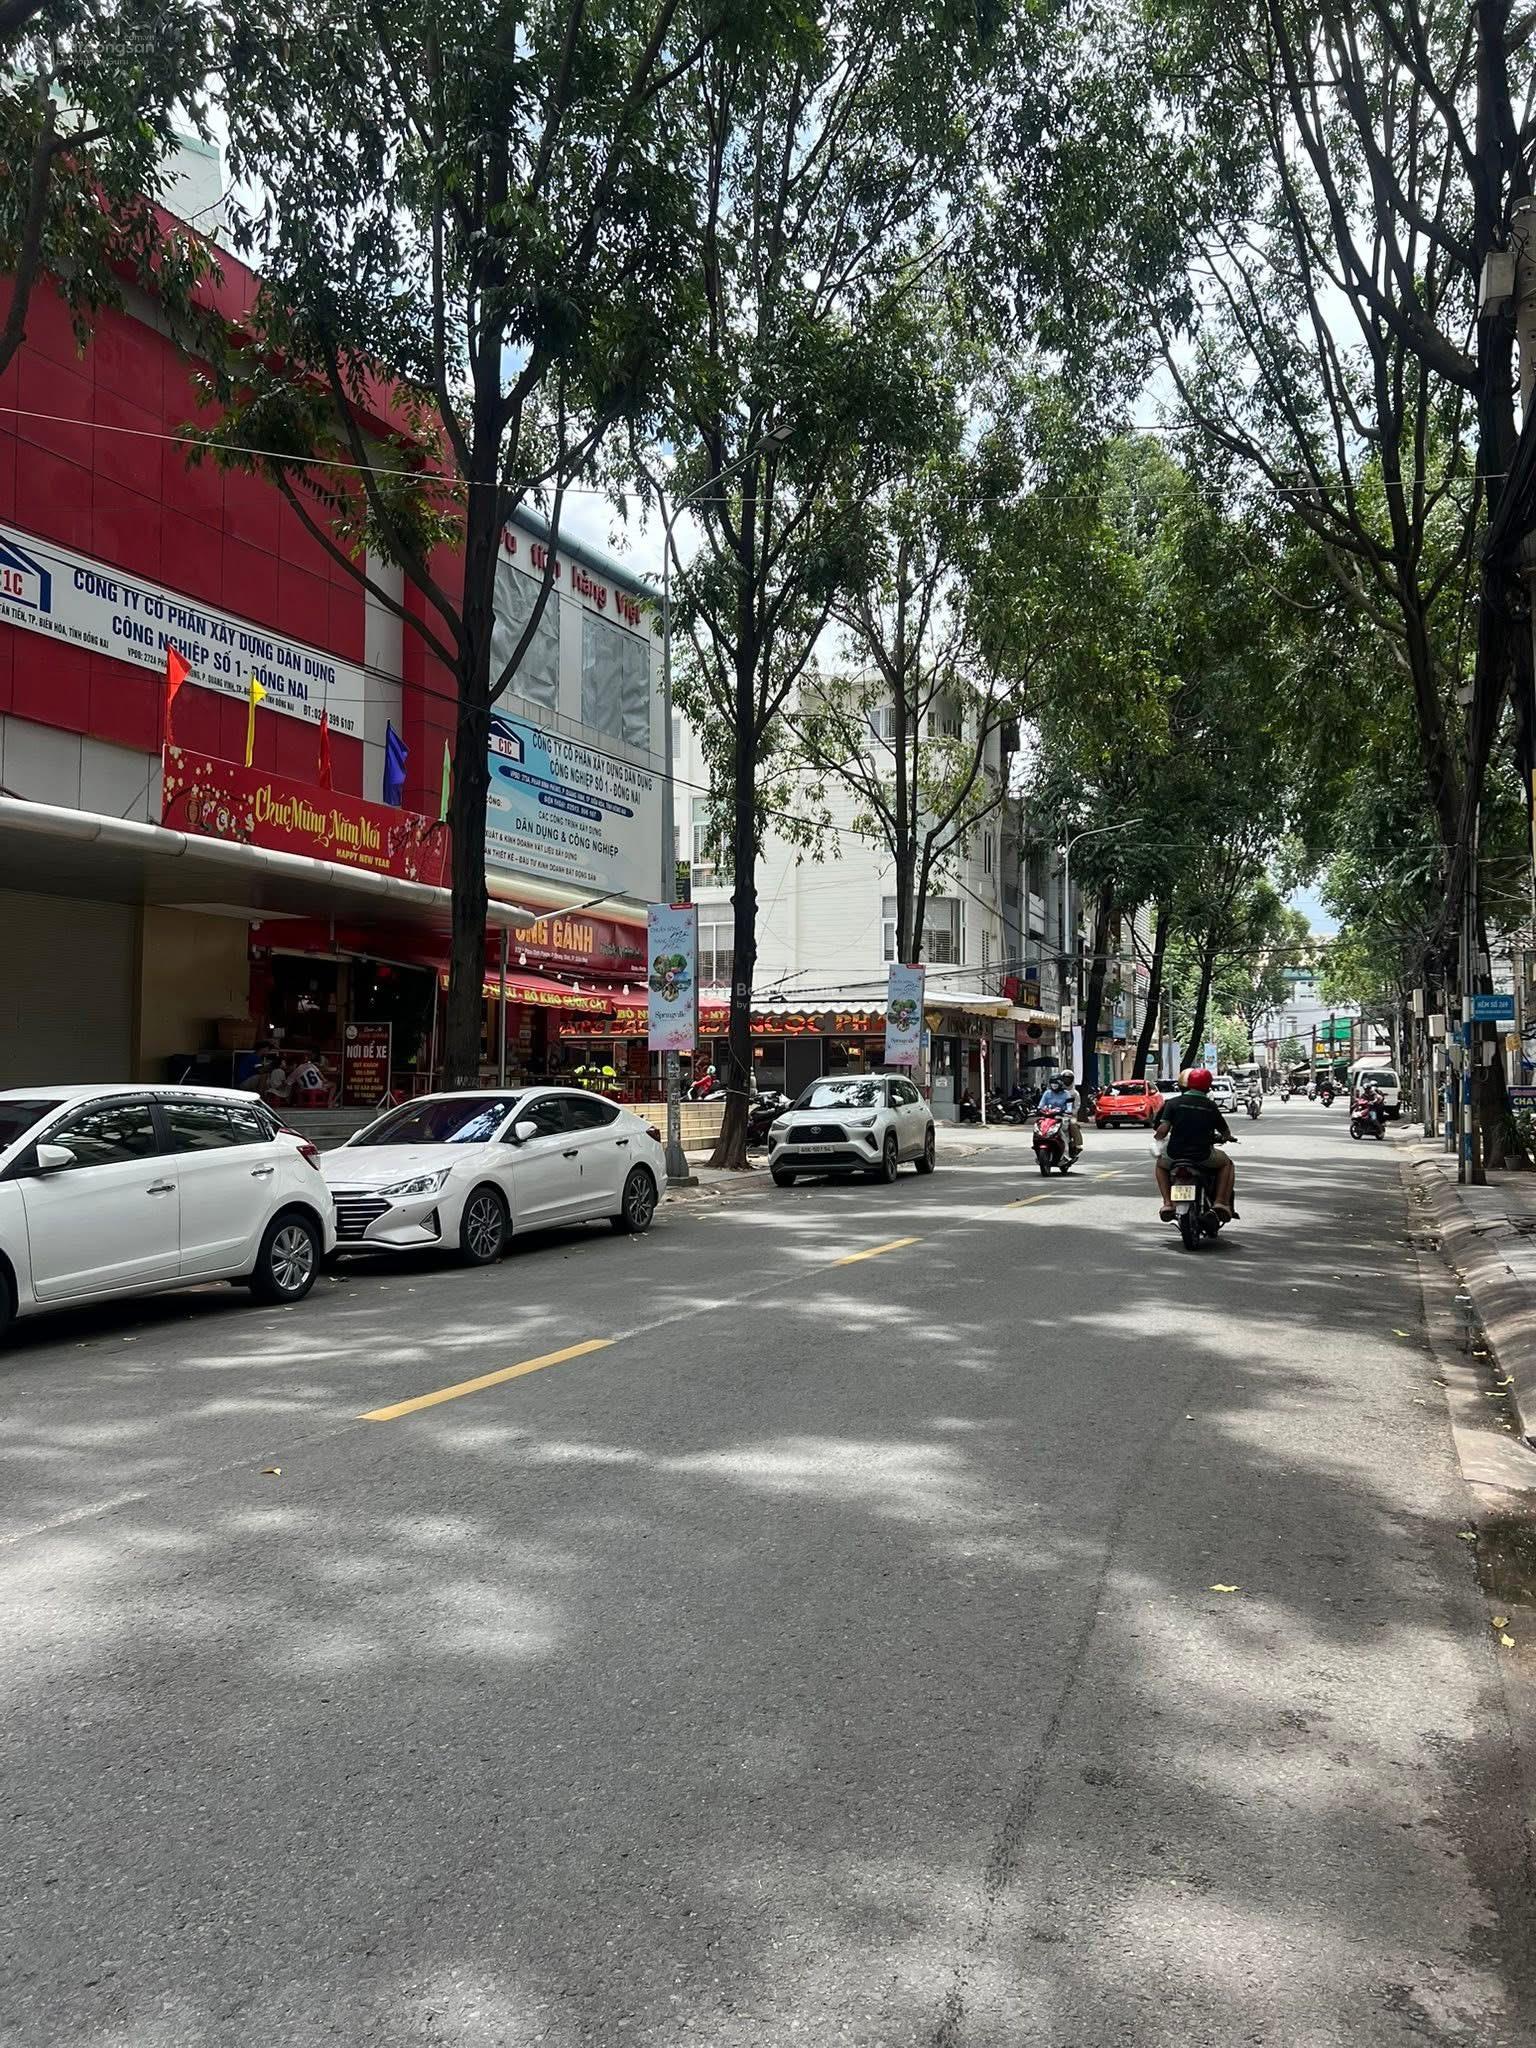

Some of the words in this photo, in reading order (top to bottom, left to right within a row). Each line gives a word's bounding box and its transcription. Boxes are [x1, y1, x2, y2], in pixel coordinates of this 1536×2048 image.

[0, 568, 23, 596] 1C
[73, 568, 118, 603] CÔNG
[122, 587, 140, 611] TY
[210, 621, 236, 647] XÂY
[277, 647, 301, 672] DÂN
[304, 657, 335, 684] DỤNG
[112, 615, 154, 647] CÔNG
[158, 631, 209, 667] NGHIỆP
[213, 650, 231, 673] SỐ
[288, 678, 308, 701] NAI
[498, 737, 512, 756] C1C
[553, 739, 562, 757] TY
[550, 757, 569, 778] CÔNG
[570, 768, 594, 791] NGHIỆP
[594, 774, 604, 792] SỐ
[630, 789, 641, 805] NAI
[255, 783, 292, 832] Chúc
[329, 808, 361, 848] Năm
[515, 817, 533, 833] DÂN
[536, 824, 559, 841] DỤNG
[560, 831, 567, 842] &
[568, 832, 590, 850] CÔNG
[592, 840, 619, 859] NGHIỆP
[336, 848, 359, 863] HAPPY
[359, 853, 374, 866] NEW
[374, 856, 391, 869] YEAR
[553, 915, 593, 954] GÁNH
[376, 1045, 387, 1058] XE
